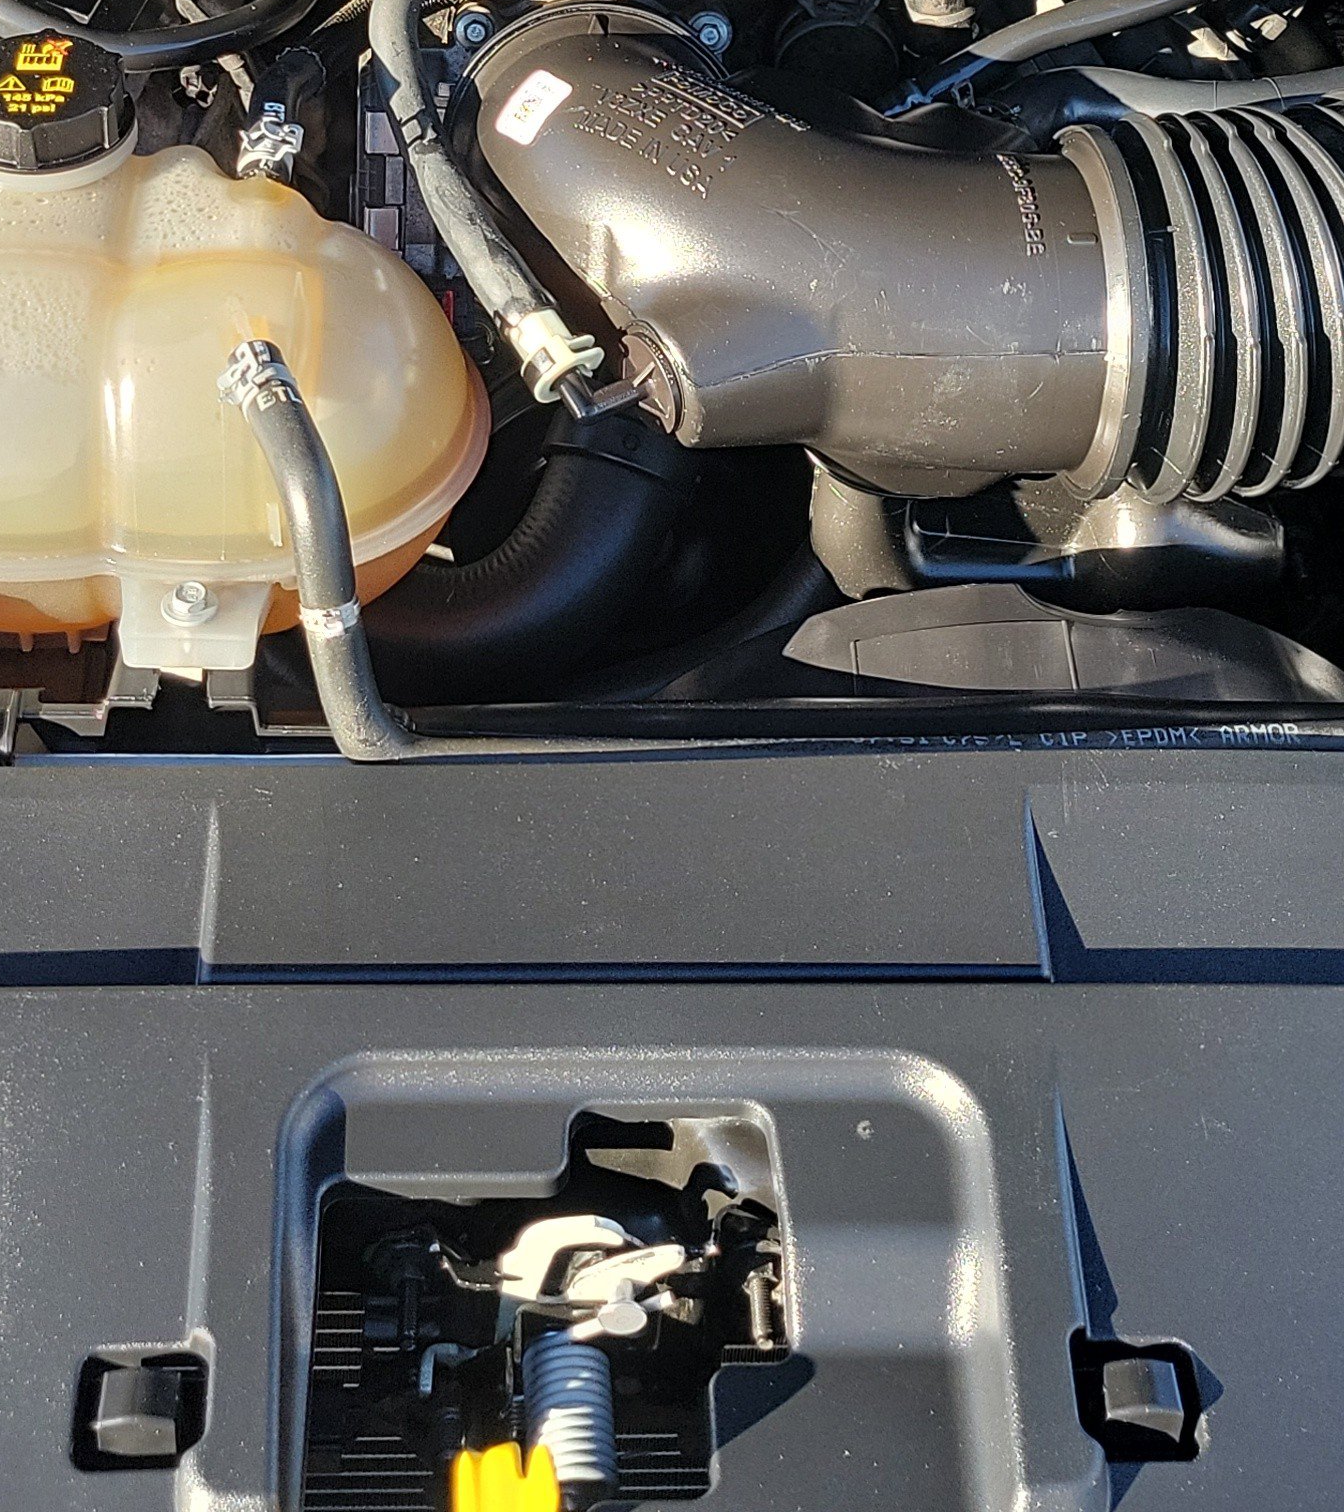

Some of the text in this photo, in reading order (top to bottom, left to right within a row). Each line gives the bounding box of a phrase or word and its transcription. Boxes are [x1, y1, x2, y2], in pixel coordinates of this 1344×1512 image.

[34, 92, 65, 103] kPa
[30, 103, 56, 115] psi
[573, 108, 714, 200] MADE IN USA
[1218, 722, 1302, 745] ARMOR
